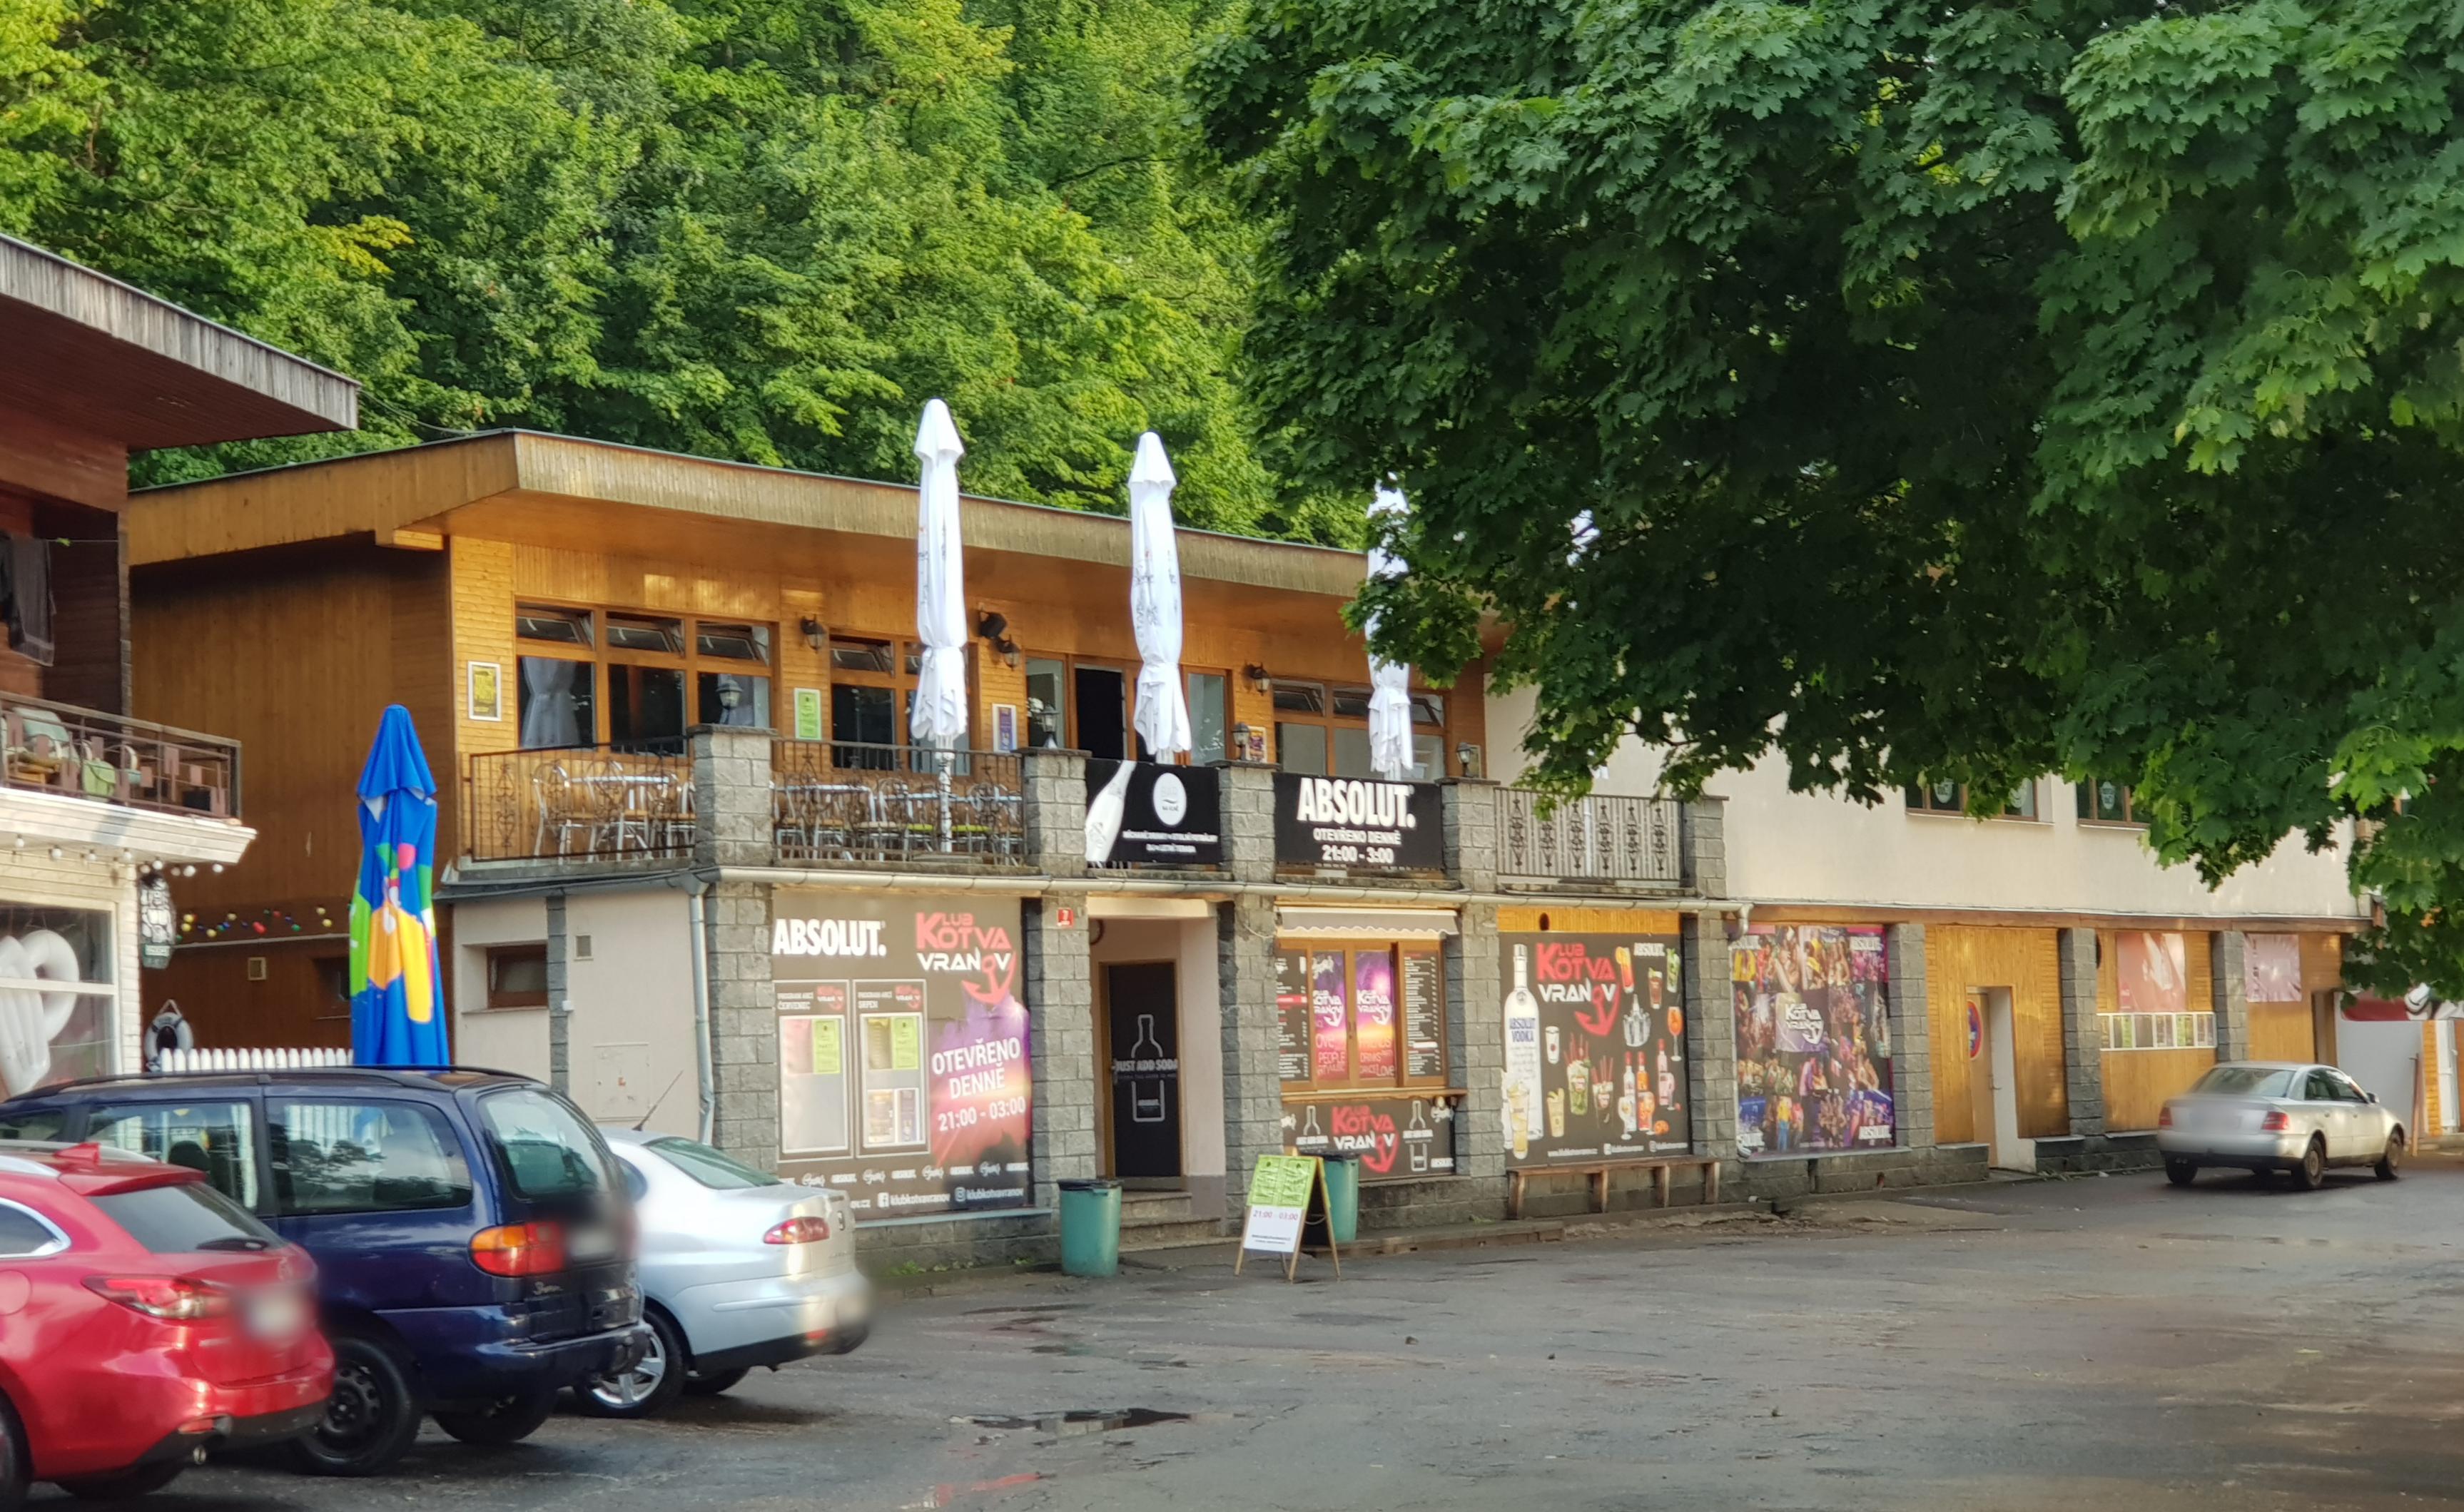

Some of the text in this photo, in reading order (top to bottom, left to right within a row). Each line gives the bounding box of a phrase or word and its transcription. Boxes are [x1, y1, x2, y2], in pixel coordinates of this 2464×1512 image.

[1313, 826, 1401, 845] OTEVŘENO DENNĚ
[1322, 844, 1358, 861] 21:00
[1366, 846, 1394, 863] 3:00
[916, 912, 1013, 950] KOTVA
[1536, 943, 1616, 980] KOTVA
[932, 1037, 1021, 1075] OTEVŘENO
[948, 1062, 1005, 1100] DENNĚ
[938, 1106, 977, 1132] 21:00
[989, 1096, 1026, 1120] 03:00
[1332, 1106, 1395, 1135] KOTVA
